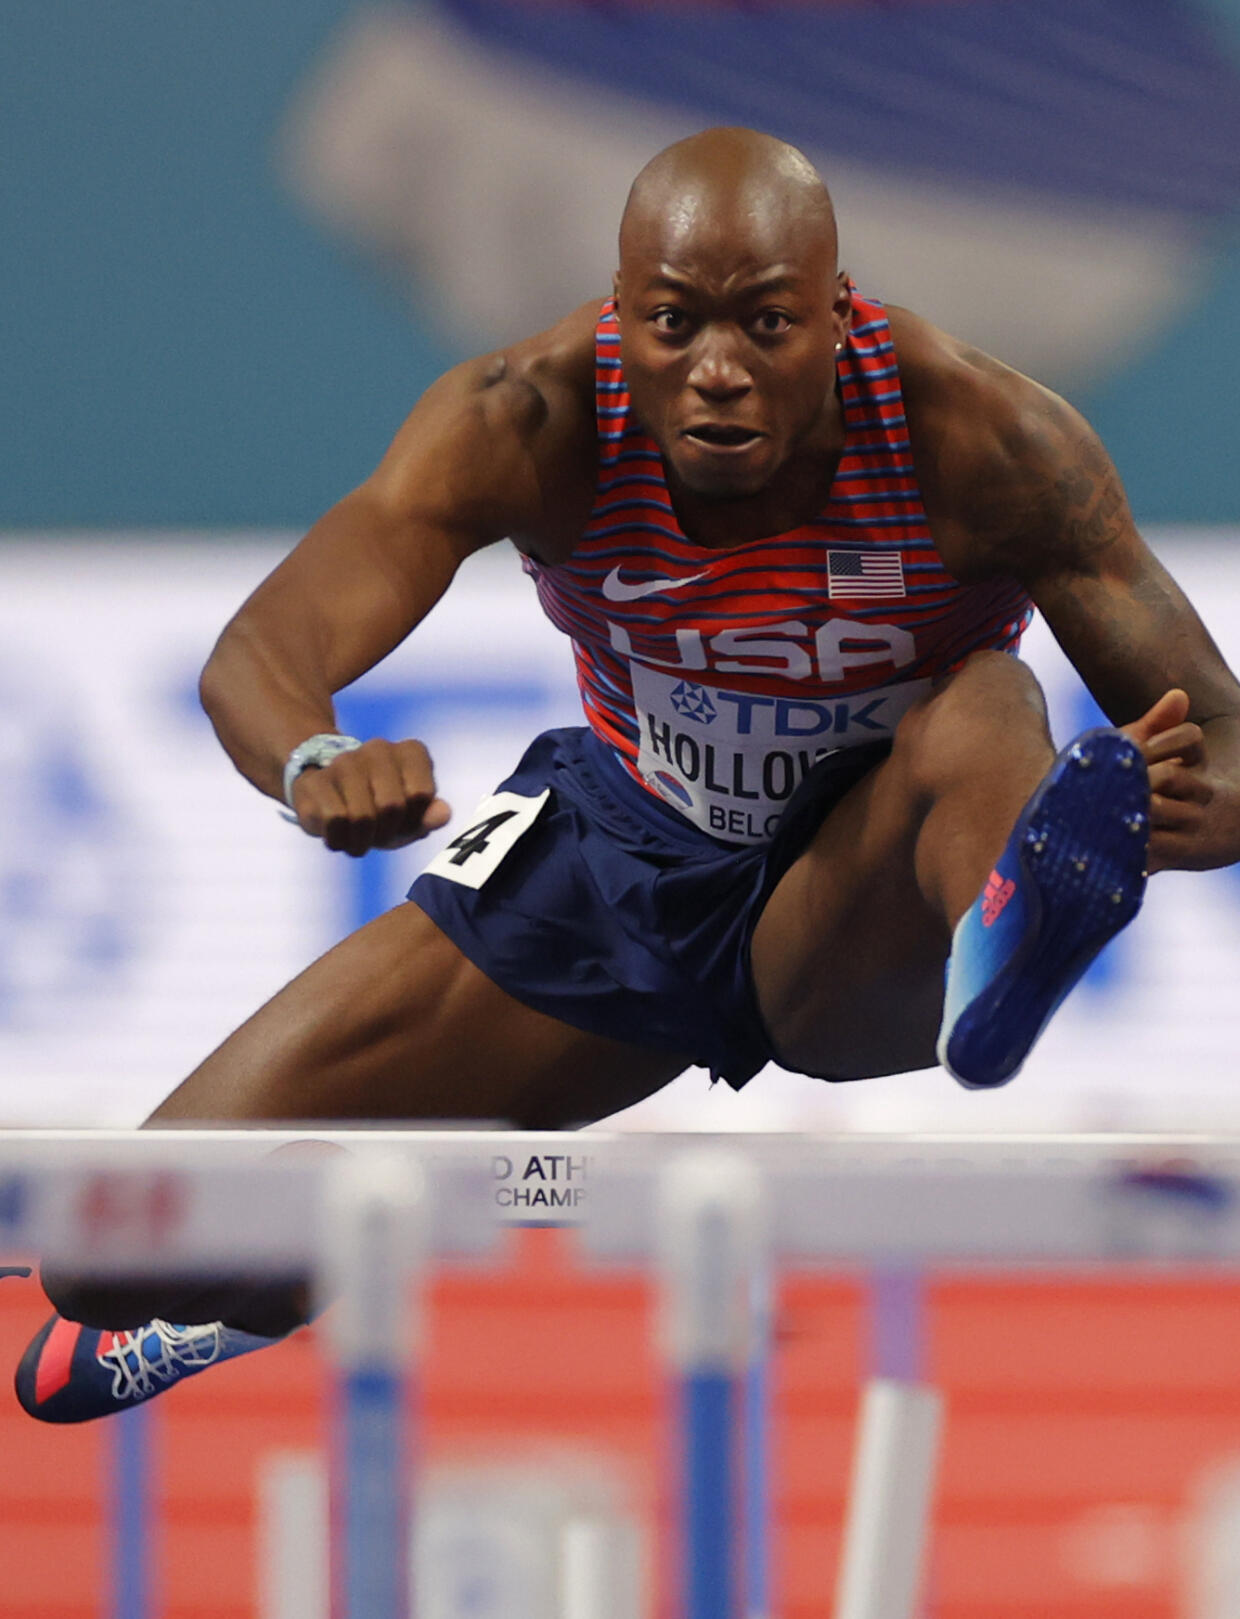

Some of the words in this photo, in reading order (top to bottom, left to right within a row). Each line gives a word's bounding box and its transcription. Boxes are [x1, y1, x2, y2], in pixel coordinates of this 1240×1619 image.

[607, 618, 916, 682] USA
[717, 690, 889, 737] TDK
[446, 810, 520, 867] 4
